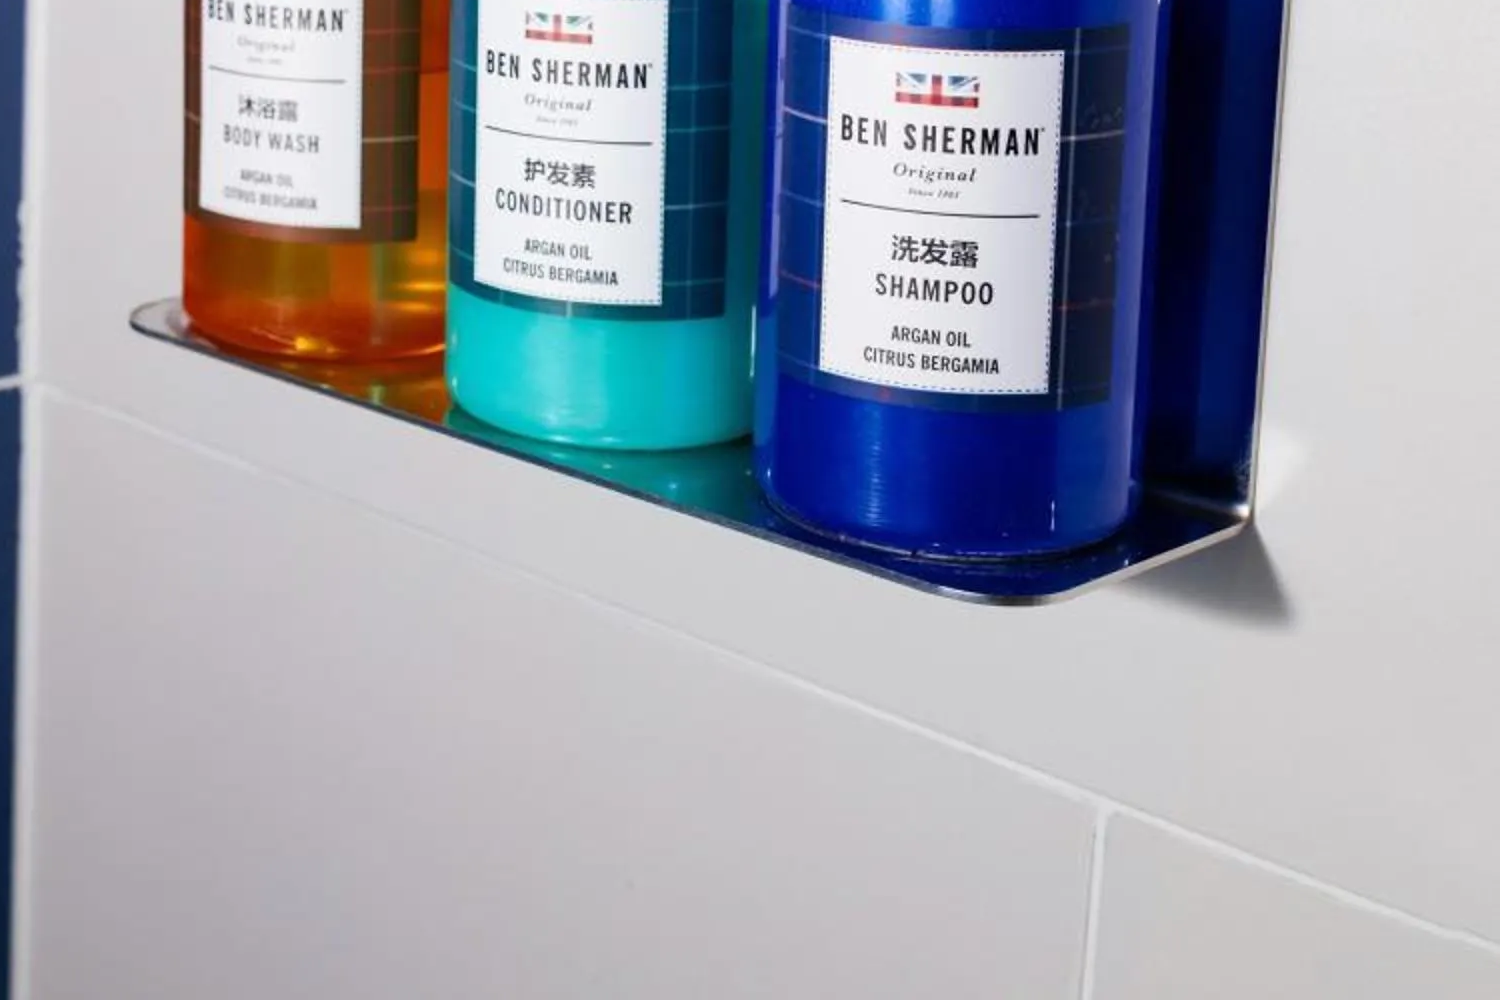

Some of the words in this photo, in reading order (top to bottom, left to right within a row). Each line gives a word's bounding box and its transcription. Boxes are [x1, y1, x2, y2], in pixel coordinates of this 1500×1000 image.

[244, 4, 344, 32] SHERMAN
[487, 49, 520, 79] BEN
[532, 58, 648, 89] SHERMAN
[524, 93, 593, 112] Original
[223, 124, 261, 149] BODY
[269, 132, 320, 153] WASH
[841, 114, 887, 147] BEN
[903, 124, 1040, 156] SHERMAN
[524, 158, 596, 188] 护发素
[893, 162, 977, 183] Original
[495, 187, 632, 224] CONDITIONER
[524, 238, 565, 257] ARGAN
[570, 243, 593, 260] OIL
[891, 235, 979, 269] 洗发露
[503, 257, 545, 279] CITRUS
[549, 265, 619, 286] BERGAMIA
[875, 273, 994, 305] SHAMPOO
[891, 326, 941, 346] ARGAN
[946, 331, 971, 348] OIL
[863, 346, 915, 369] CITRUS
[921, 353, 1000, 375] BERGAMIA
